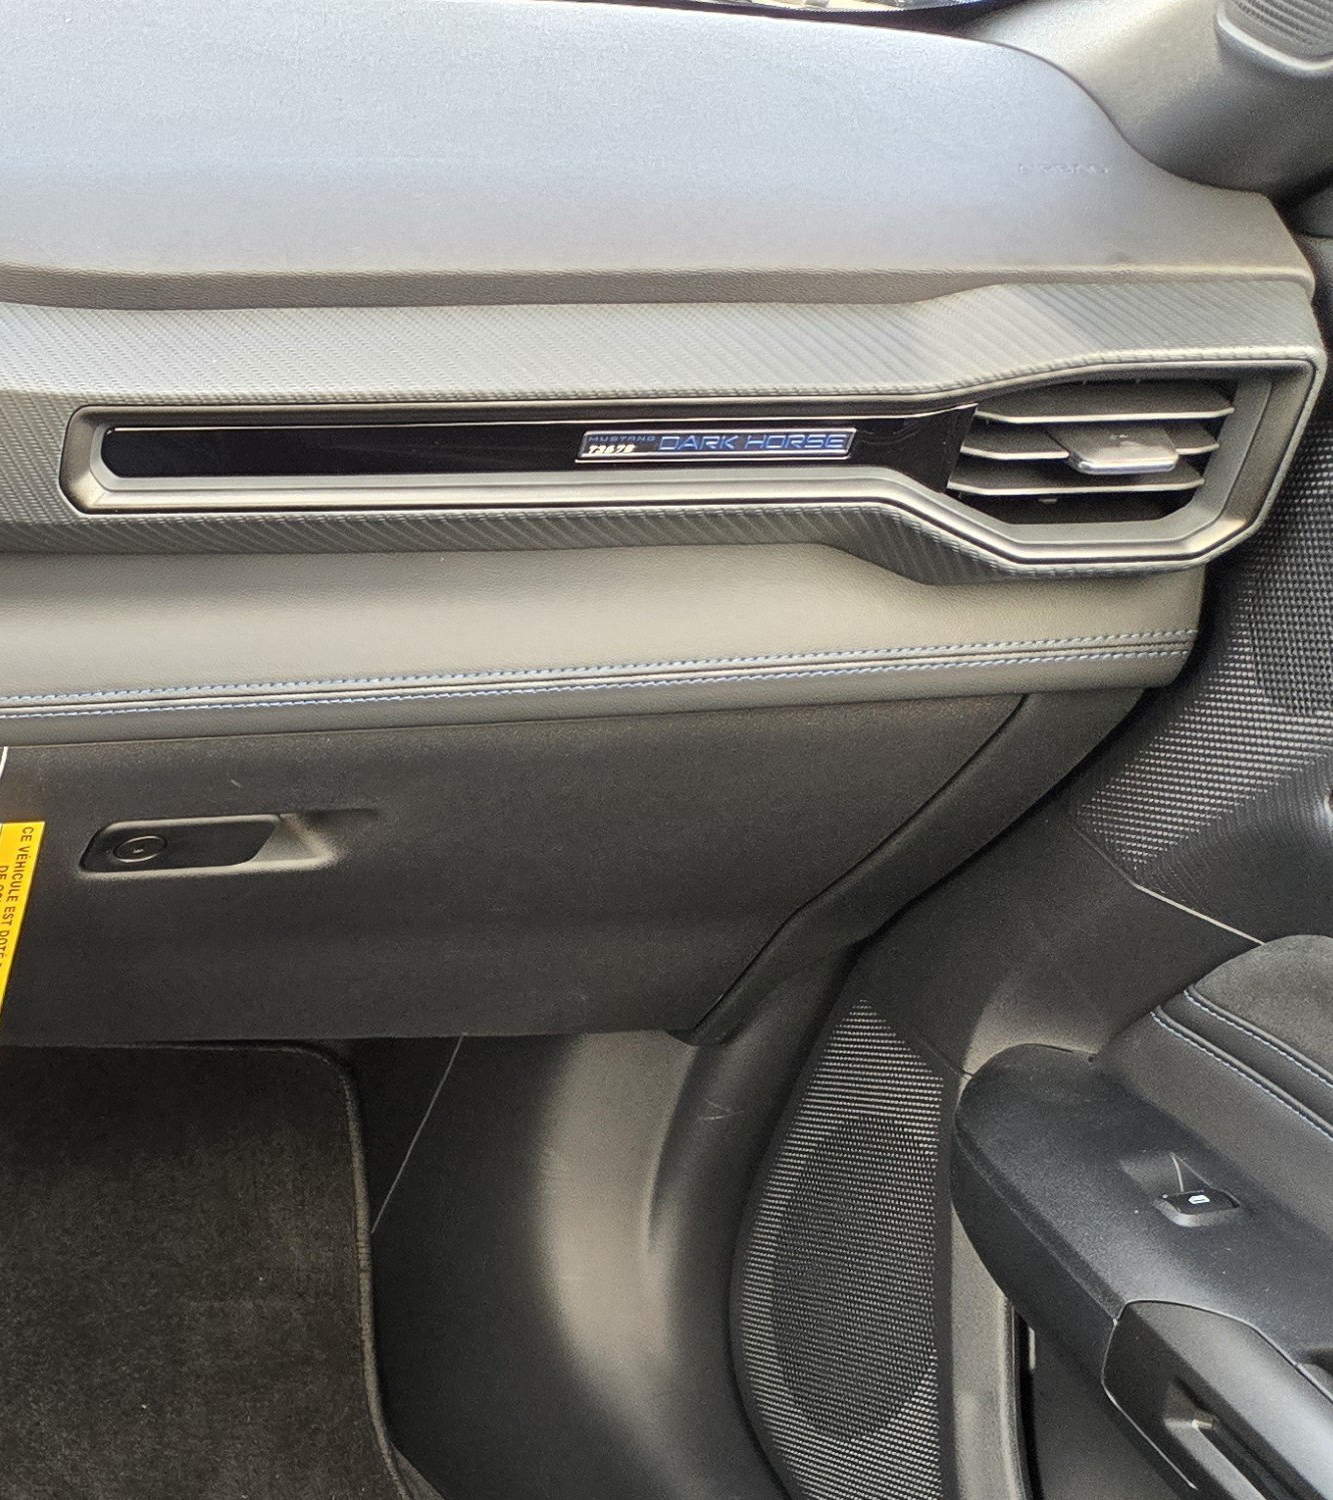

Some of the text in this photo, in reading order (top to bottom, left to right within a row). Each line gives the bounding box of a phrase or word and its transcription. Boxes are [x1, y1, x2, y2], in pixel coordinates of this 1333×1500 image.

[588, 435, 656, 443] MUSTANG
[658, 433, 847, 451] DARK HORSE
[19, 826, 34, 841] CE
[6, 845, 33, 901] VÉHICULE
[0, 906, 15, 925] EST
